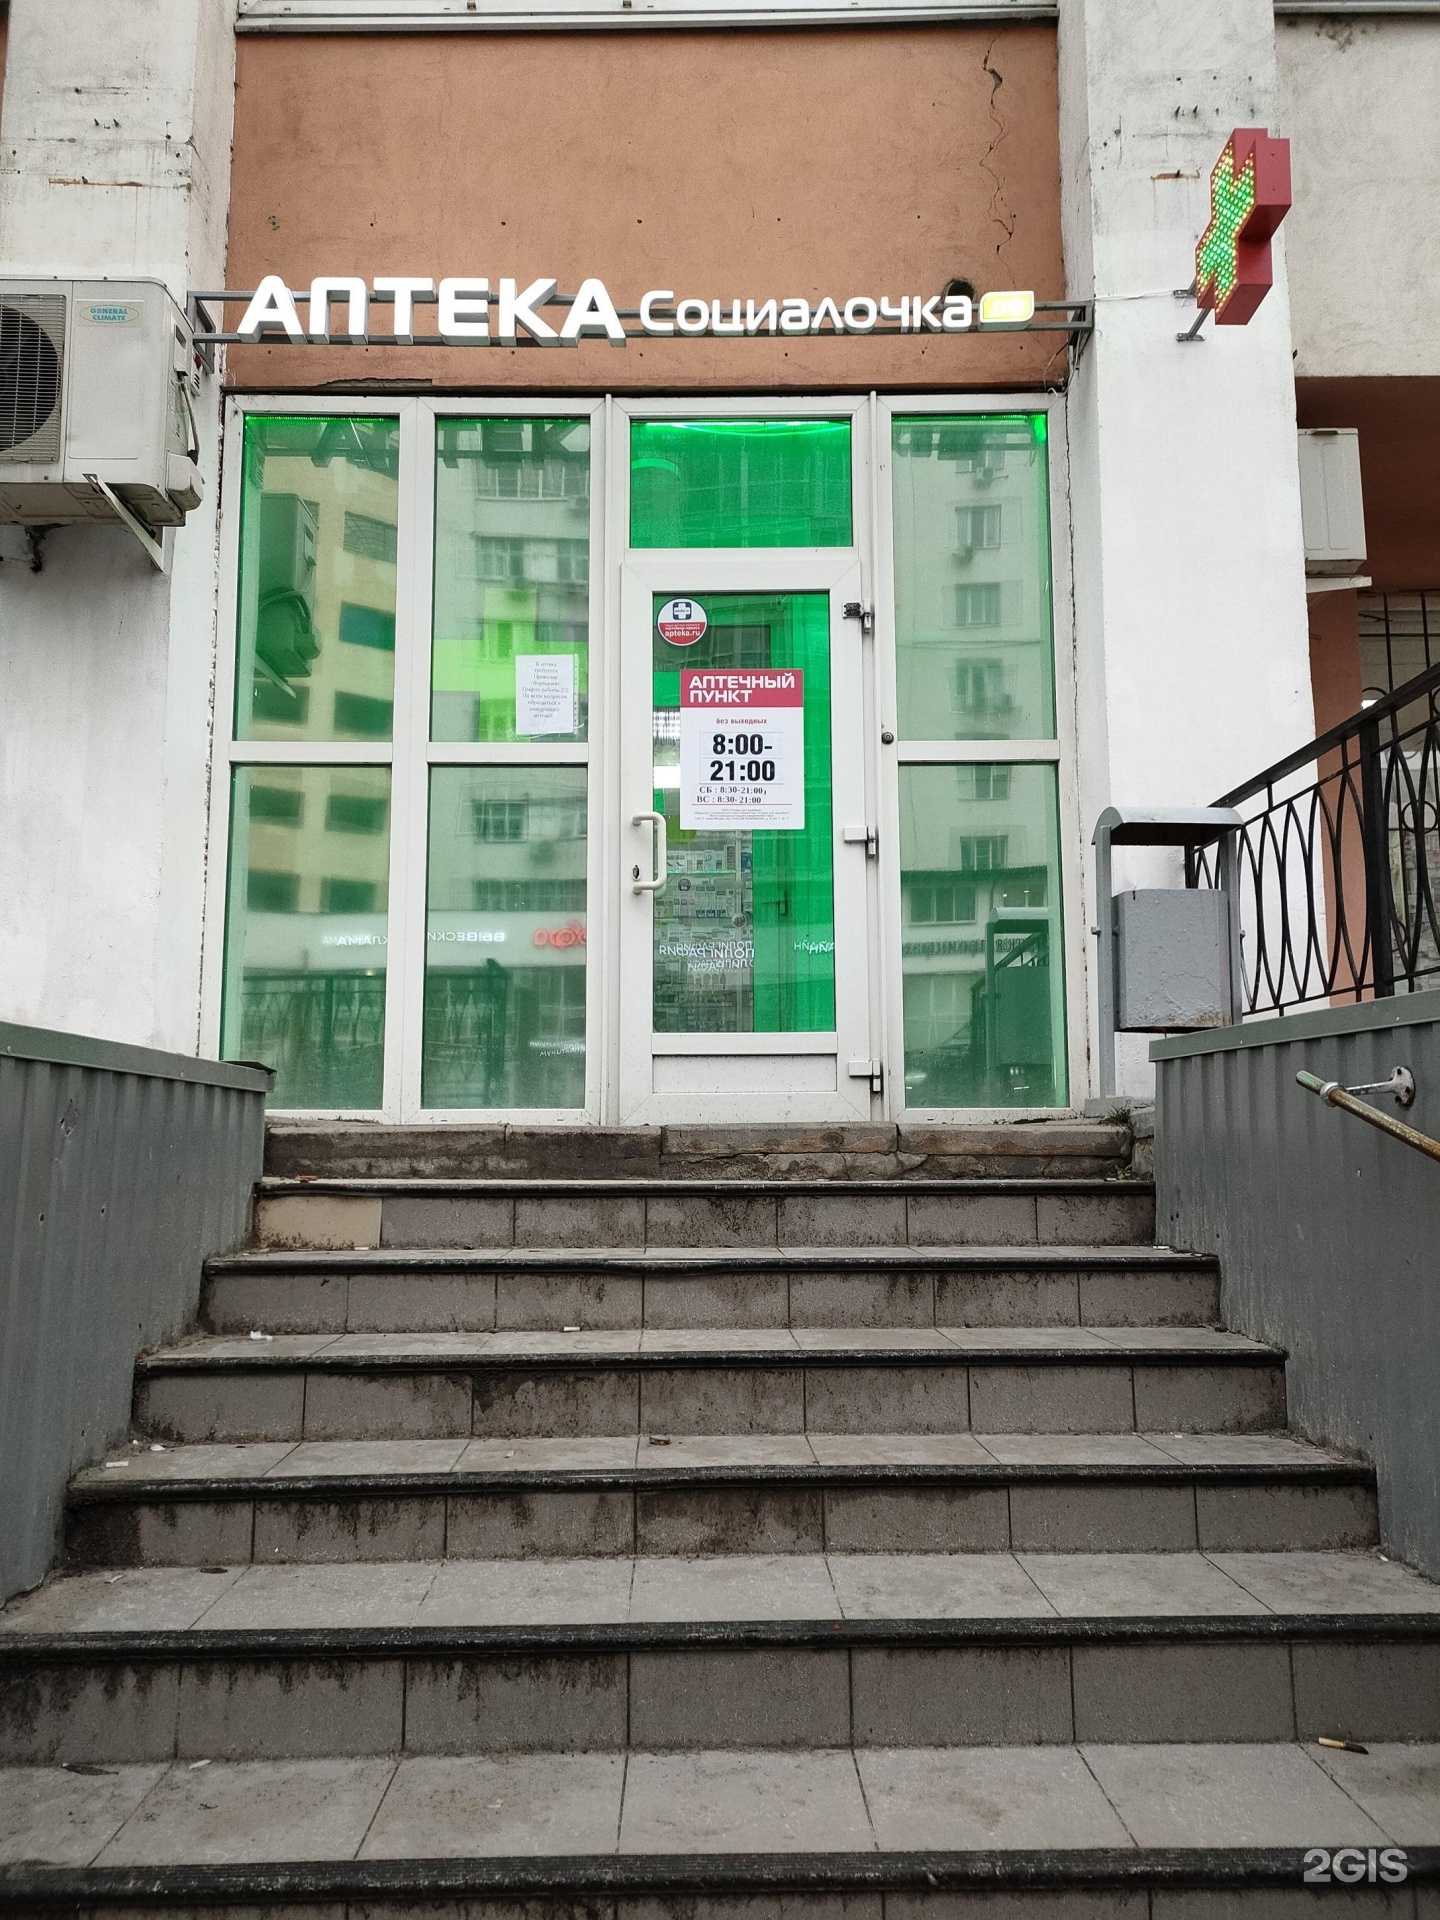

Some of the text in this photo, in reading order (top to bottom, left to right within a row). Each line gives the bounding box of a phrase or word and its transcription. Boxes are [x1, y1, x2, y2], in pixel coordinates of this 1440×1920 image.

[236, 274, 973, 347] АПТЕКА Социалочка
[689, 672, 795, 688] АПТЕЧНЫЙ
[690, 690, 752, 703] ПУНКТ
[713, 733, 773, 755] 8:00-
[710, 760, 775, 781] 21:00
